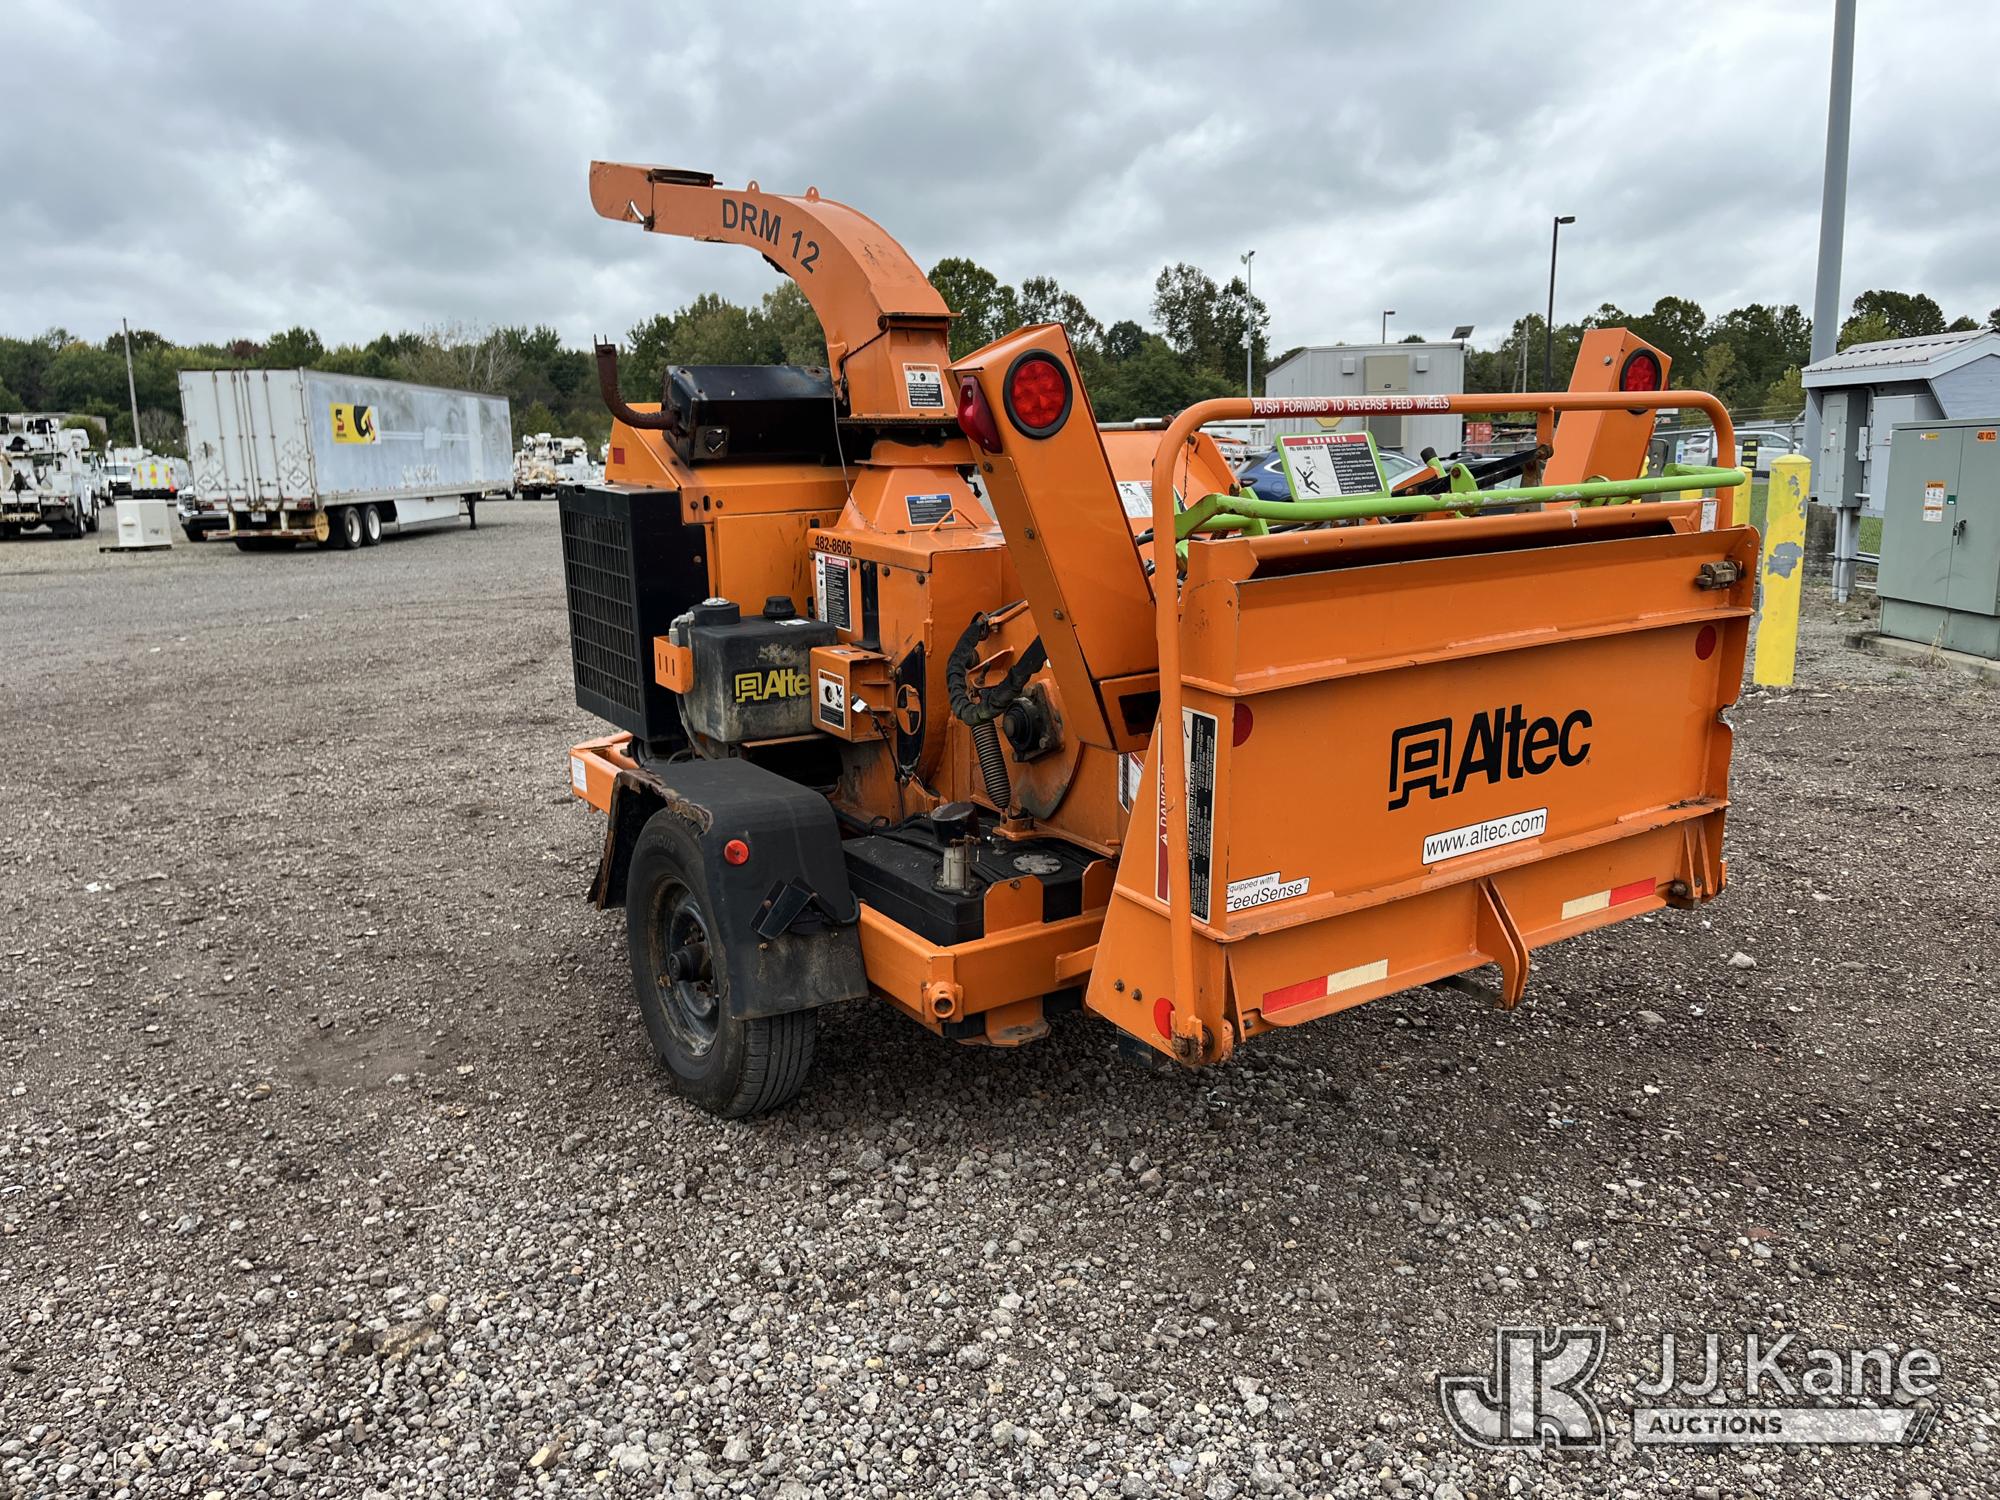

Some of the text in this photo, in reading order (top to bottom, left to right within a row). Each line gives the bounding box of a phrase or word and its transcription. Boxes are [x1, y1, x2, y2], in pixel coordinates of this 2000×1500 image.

[722, 198, 820, 274] DRM 12
[1253, 396, 1450, 414] PUSH FORWARD TO REVERSE FEED WHEELS
[815, 535, 852, 556] 482-8606
[762, 668, 812, 700] Alte
[1451, 704, 1593, 795] Altec
[1426, 814, 1545, 857] www.altec.com
[1227, 880, 1258, 893] quipped
